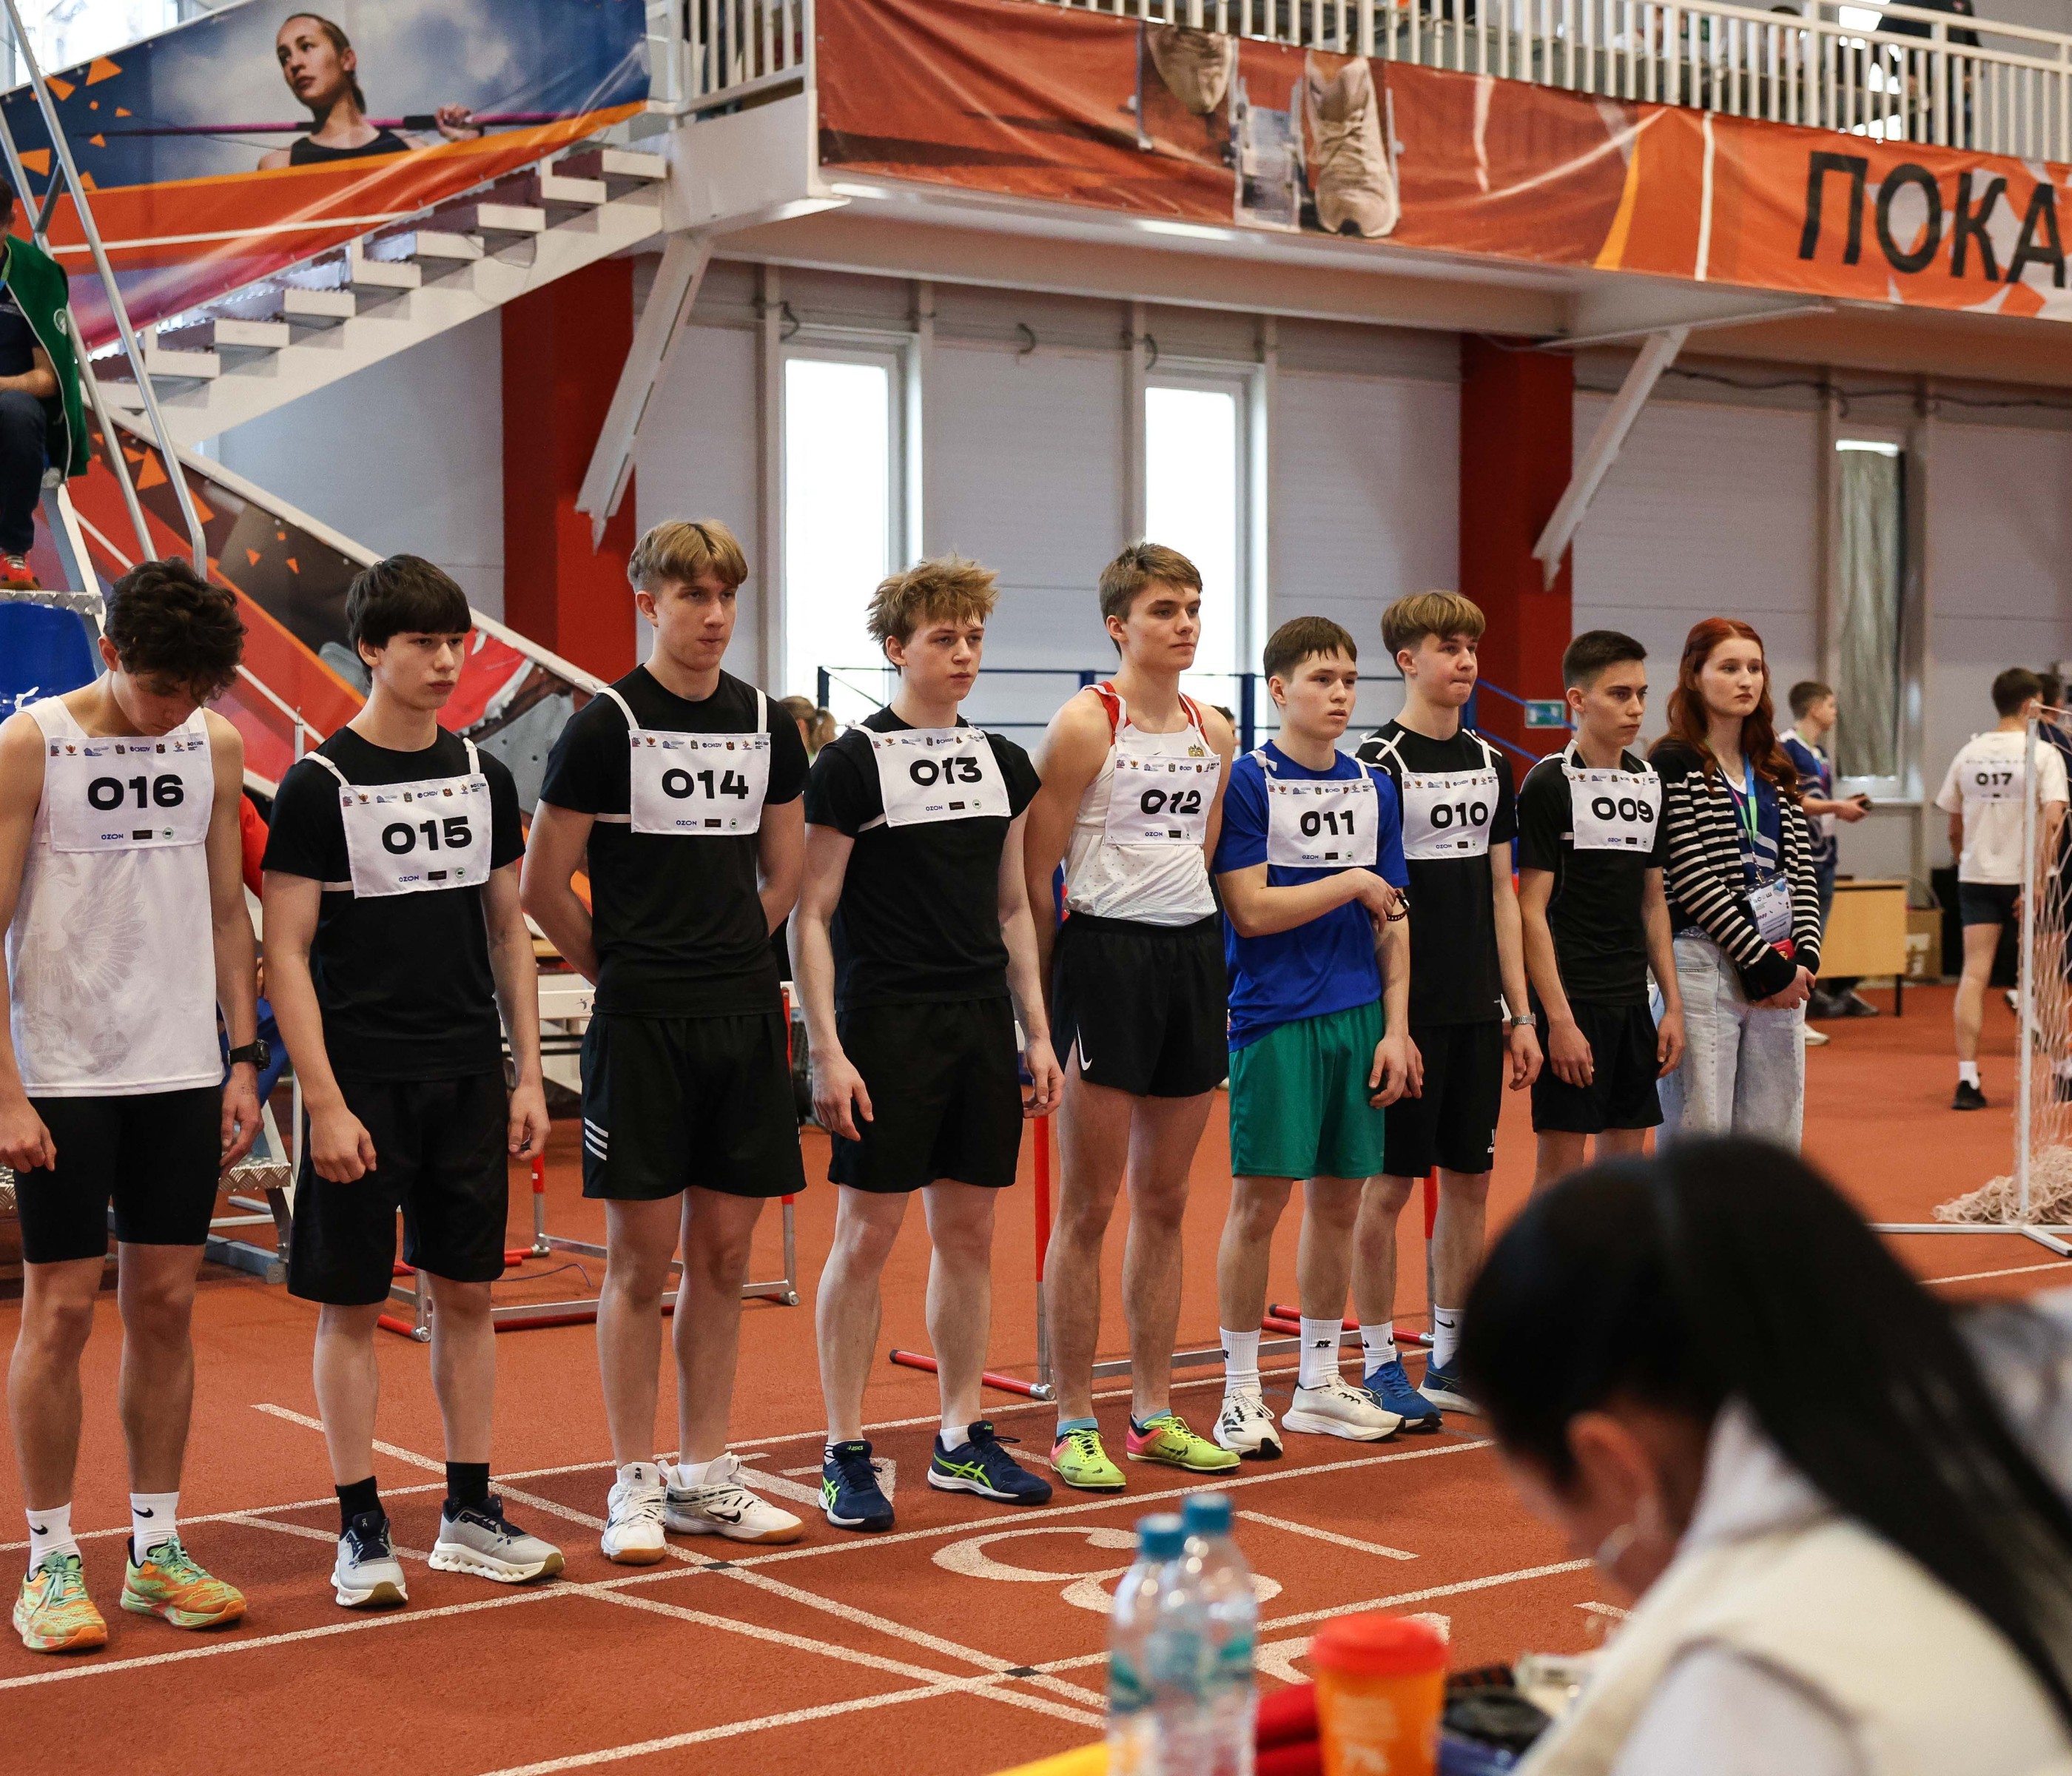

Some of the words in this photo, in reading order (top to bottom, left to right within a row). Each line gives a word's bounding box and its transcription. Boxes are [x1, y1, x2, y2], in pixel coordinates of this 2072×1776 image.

[1798, 151, 2065, 288] ПОКА
[662, 768, 749, 799] 014
[910, 757, 982, 786] 013
[1976, 773, 2012, 786] 017
[88, 774, 184, 810] 016
[1141, 790, 1201, 814] 012
[1300, 810, 1354, 836] 011
[1430, 801, 1488, 828] 010
[1592, 797, 1654, 823] 009
[382, 816, 472, 854] 015
[398, 875, 420, 883] OZON
